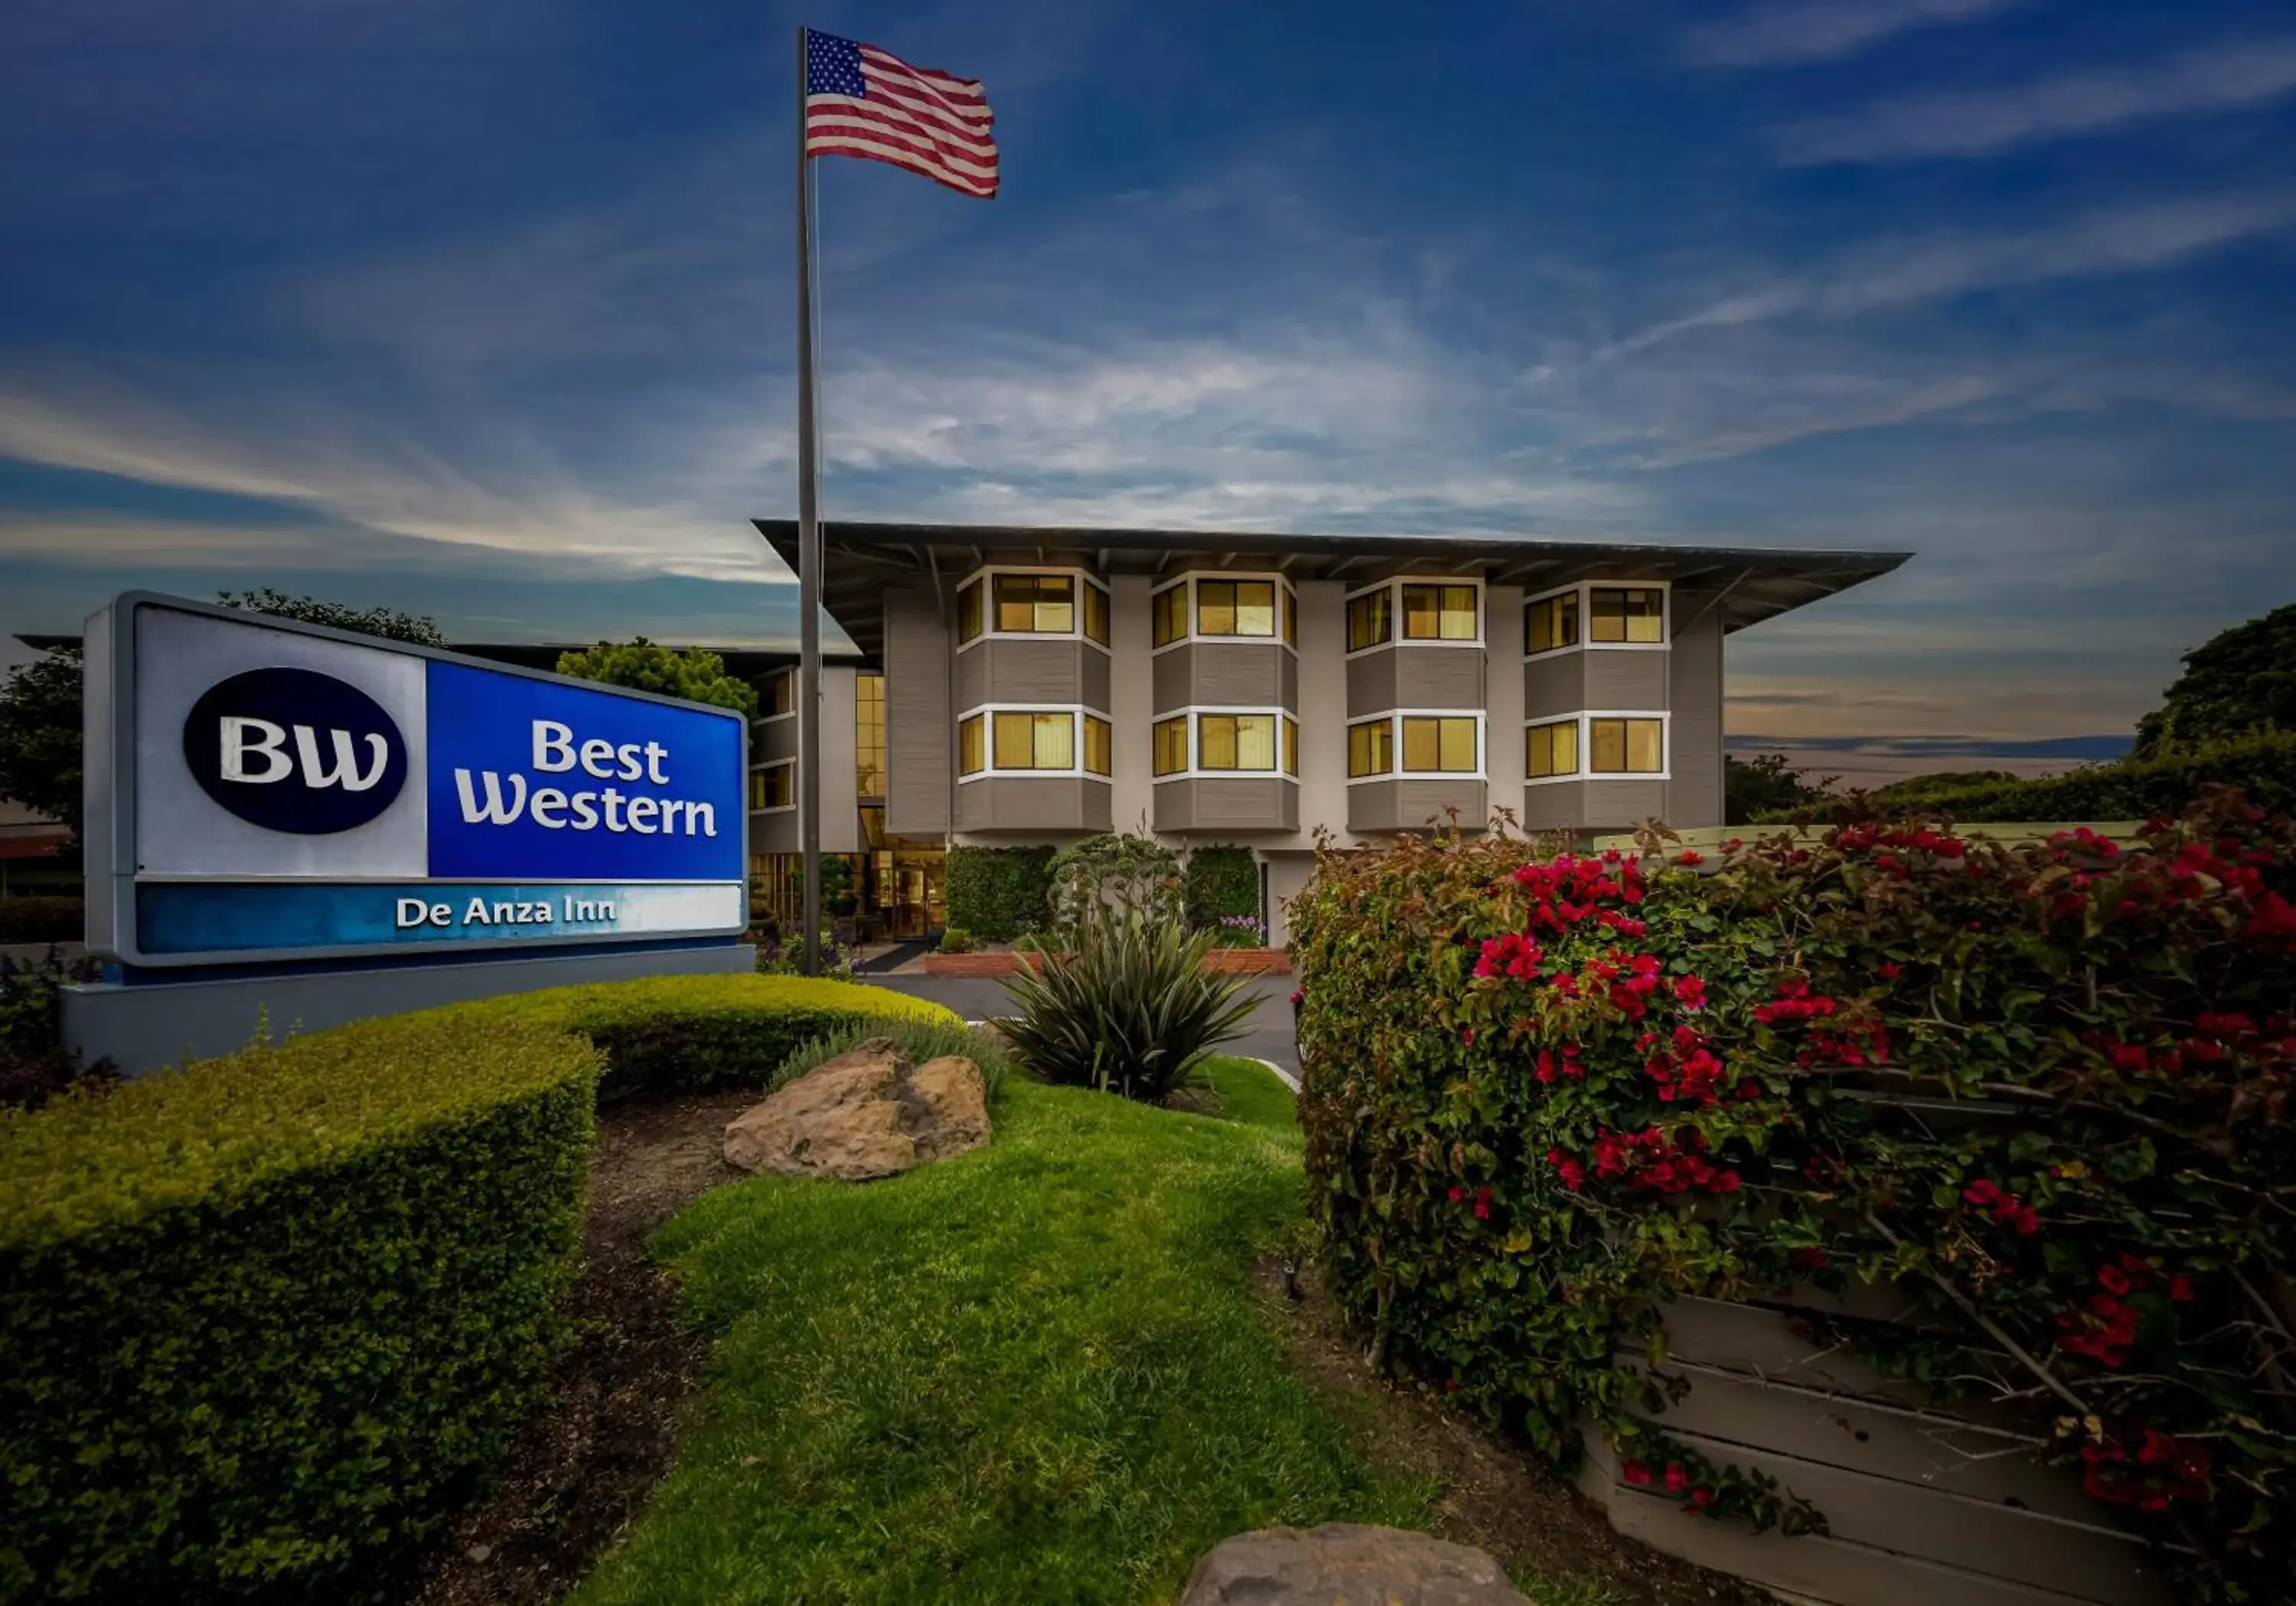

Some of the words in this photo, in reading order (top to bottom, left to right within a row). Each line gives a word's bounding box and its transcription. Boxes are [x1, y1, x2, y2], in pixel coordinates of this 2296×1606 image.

[220, 716, 388, 792] BW
[532, 720, 670, 785] Best
[455, 769, 717, 837] Western
[396, 897, 452, 928] De
[463, 897, 553, 925] Anza
[563, 896, 617, 922] Inn
